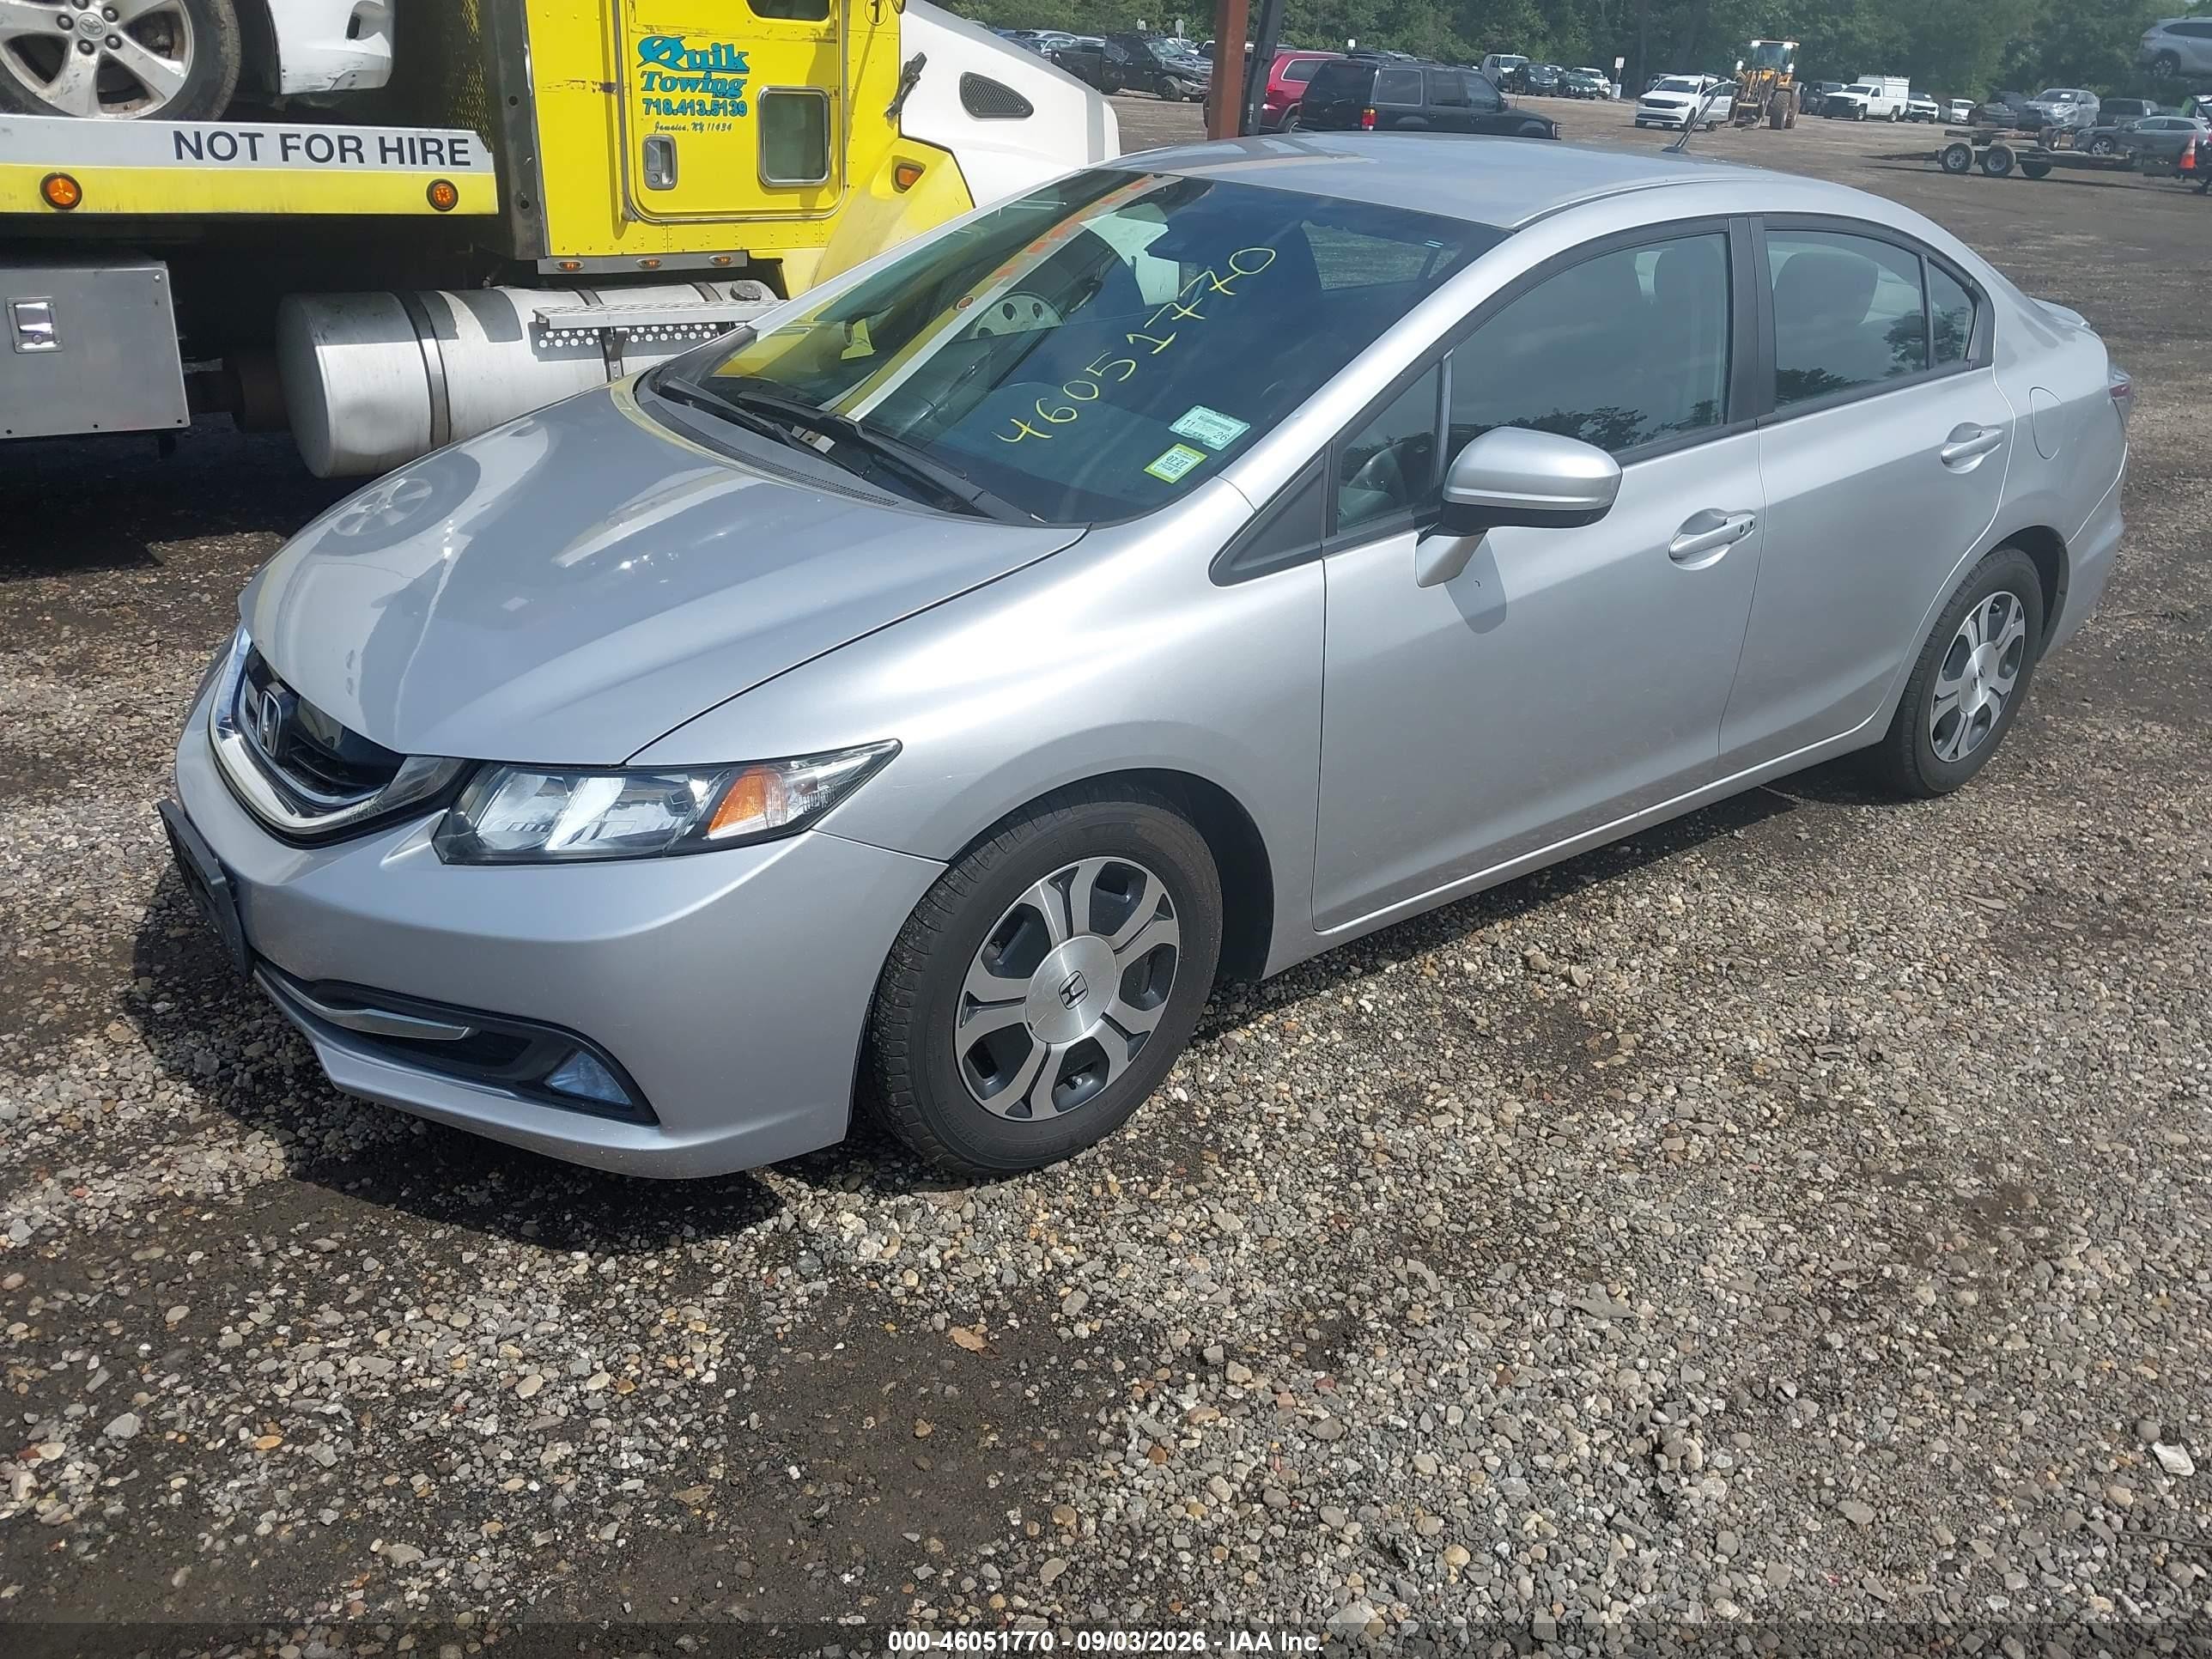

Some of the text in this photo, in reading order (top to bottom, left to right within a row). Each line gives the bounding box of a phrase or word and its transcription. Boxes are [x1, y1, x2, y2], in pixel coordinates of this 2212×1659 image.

[636, 35, 750, 74] Quik
[640, 70, 748, 99] Towing
[642, 98, 748, 117] 718.413.5139
[654, 120, 689, 133] Jamaica,
[690, 122, 706, 132] NY
[173, 130, 471, 167] NOT FOR HIRE
[991, 246, 1277, 443] 46051770
